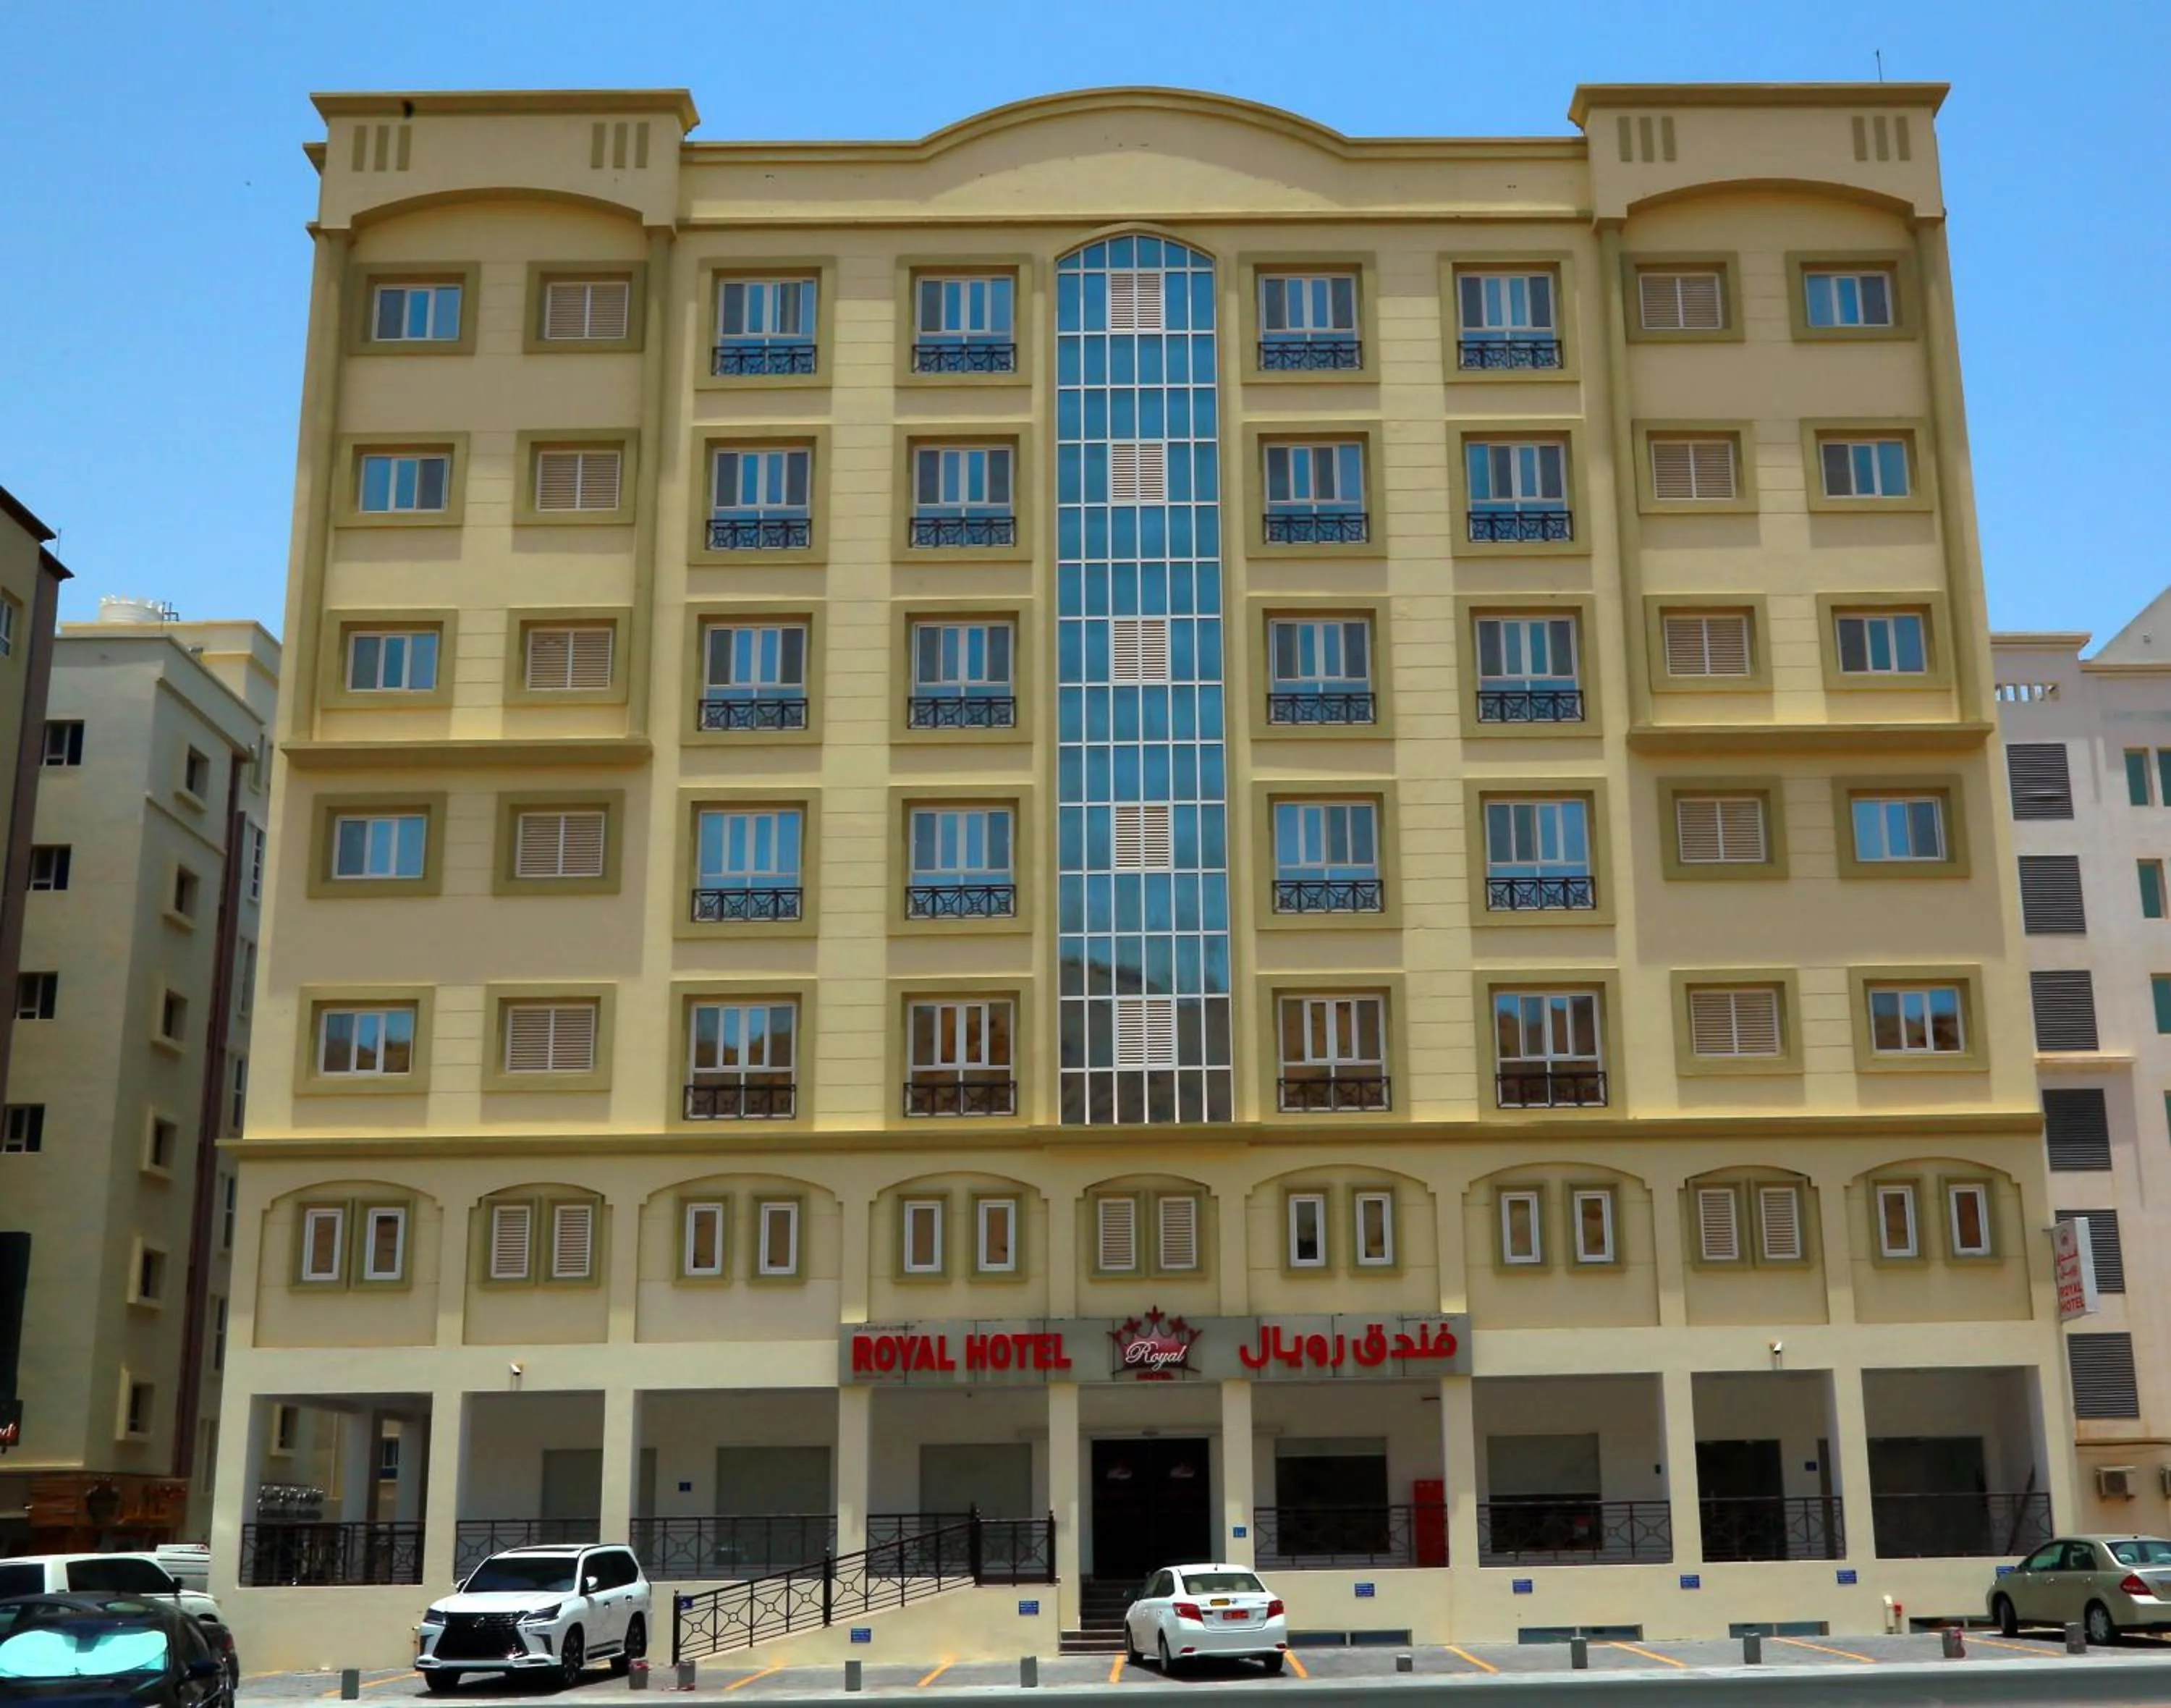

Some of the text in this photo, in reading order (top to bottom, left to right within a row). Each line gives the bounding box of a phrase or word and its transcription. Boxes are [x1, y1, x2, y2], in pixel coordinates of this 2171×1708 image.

[2059, 1281, 2083, 1298] ROYAL
[2060, 1296, 2085, 1312] HOTEL
[852, 1333, 1072, 1372] ROYAL HOTEL
[1125, 1341, 1187, 1371] Royal
[1239, 1323, 1457, 1369] فندق رويال
